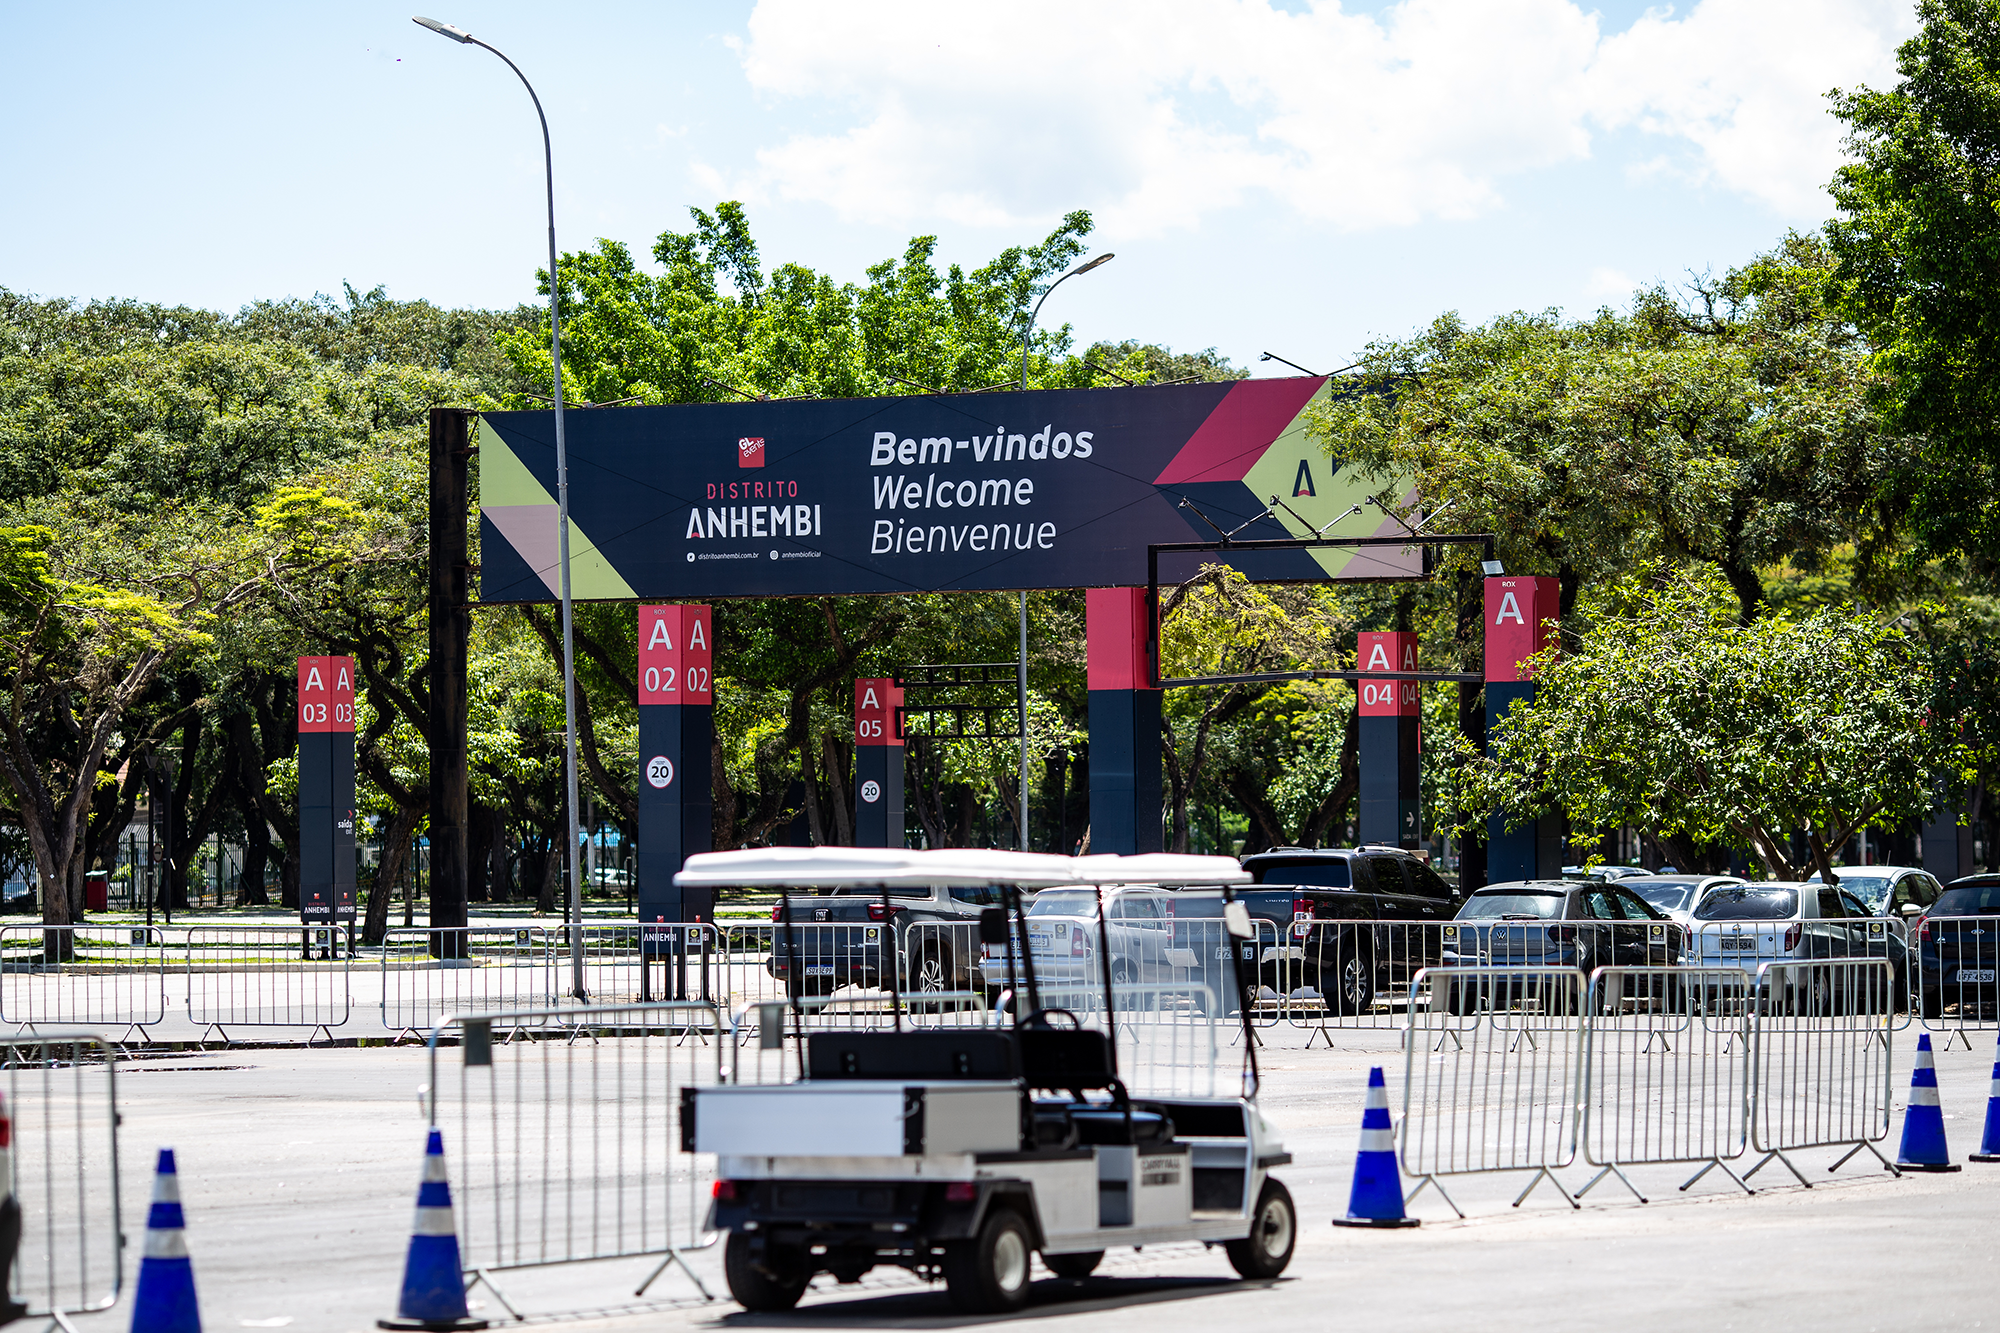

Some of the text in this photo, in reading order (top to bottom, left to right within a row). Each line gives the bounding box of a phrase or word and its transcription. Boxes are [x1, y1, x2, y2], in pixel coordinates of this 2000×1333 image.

[739, 437, 754, 450] GL
[743, 438, 765, 458] events
[870, 423, 1094, 466] Bem-vindos
[707, 481, 798, 499] DISTRITO
[873, 472, 1034, 510] Welcome
[685, 504, 821, 539] ANHEMBI
[870, 517, 1056, 554] Bienvenue
[697, 551, 822, 560] distritoanhembi.com.br anhembioficial
[1495, 591, 1525, 625] A
[647, 619, 673, 650] A
[689, 619, 707, 650] A
[1366, 644, 1390, 670] A
[1403, 644, 1415, 670] A
[304, 667, 325, 691] A
[336, 667, 351, 691] A
[644, 667, 676, 692] 02
[687, 667, 708, 692] 02
[861, 688, 880, 709] A
[1363, 684, 1394, 706] 04
[1402, 684, 1416, 705] 04
[302, 703, 327, 723] 03
[335, 703, 352, 723] 03
[859, 720, 882, 738] 05
[651, 765, 669, 778] 20
[864, 787, 878, 796] 20
[304, 906, 330, 914] ANHEMBI
